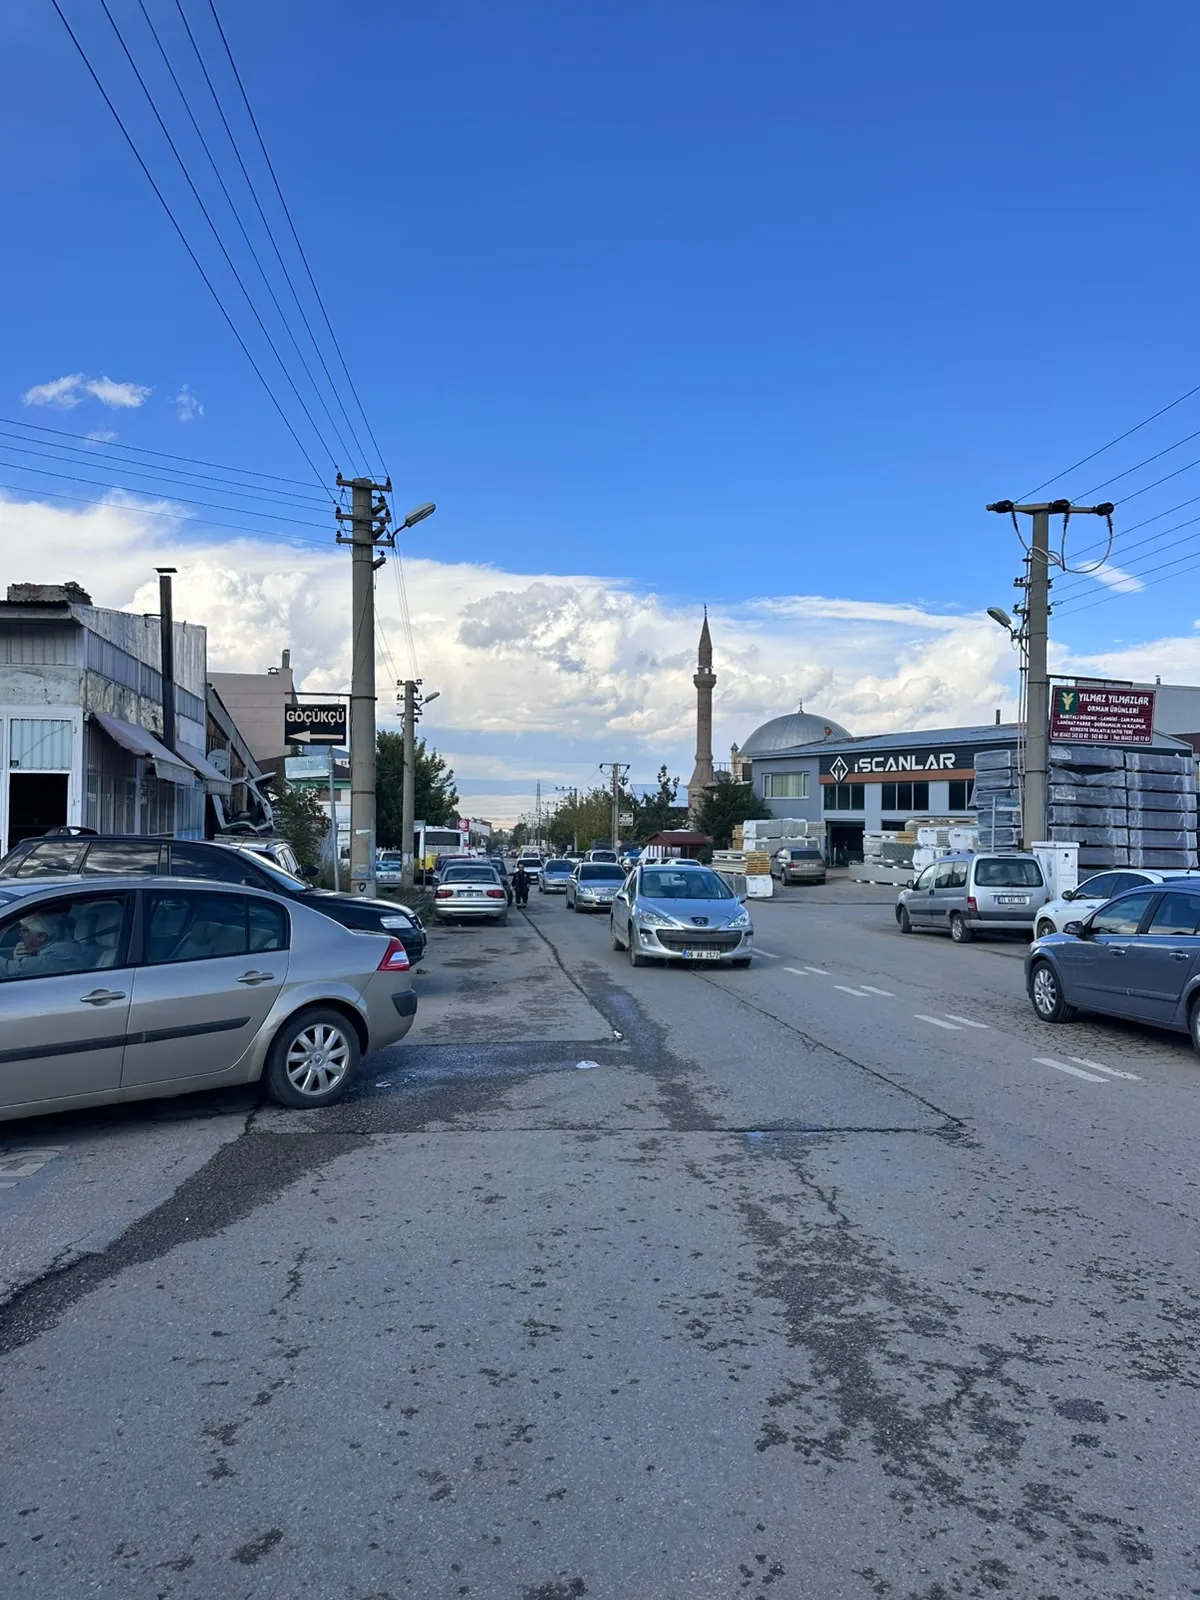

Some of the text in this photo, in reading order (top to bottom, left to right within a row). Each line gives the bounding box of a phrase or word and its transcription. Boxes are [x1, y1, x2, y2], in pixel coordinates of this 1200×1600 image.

[1079, 693, 1149, 706] YILMAZ YILMAZLAR
[286, 708, 345, 726] GÖÇÜKÇÜ
